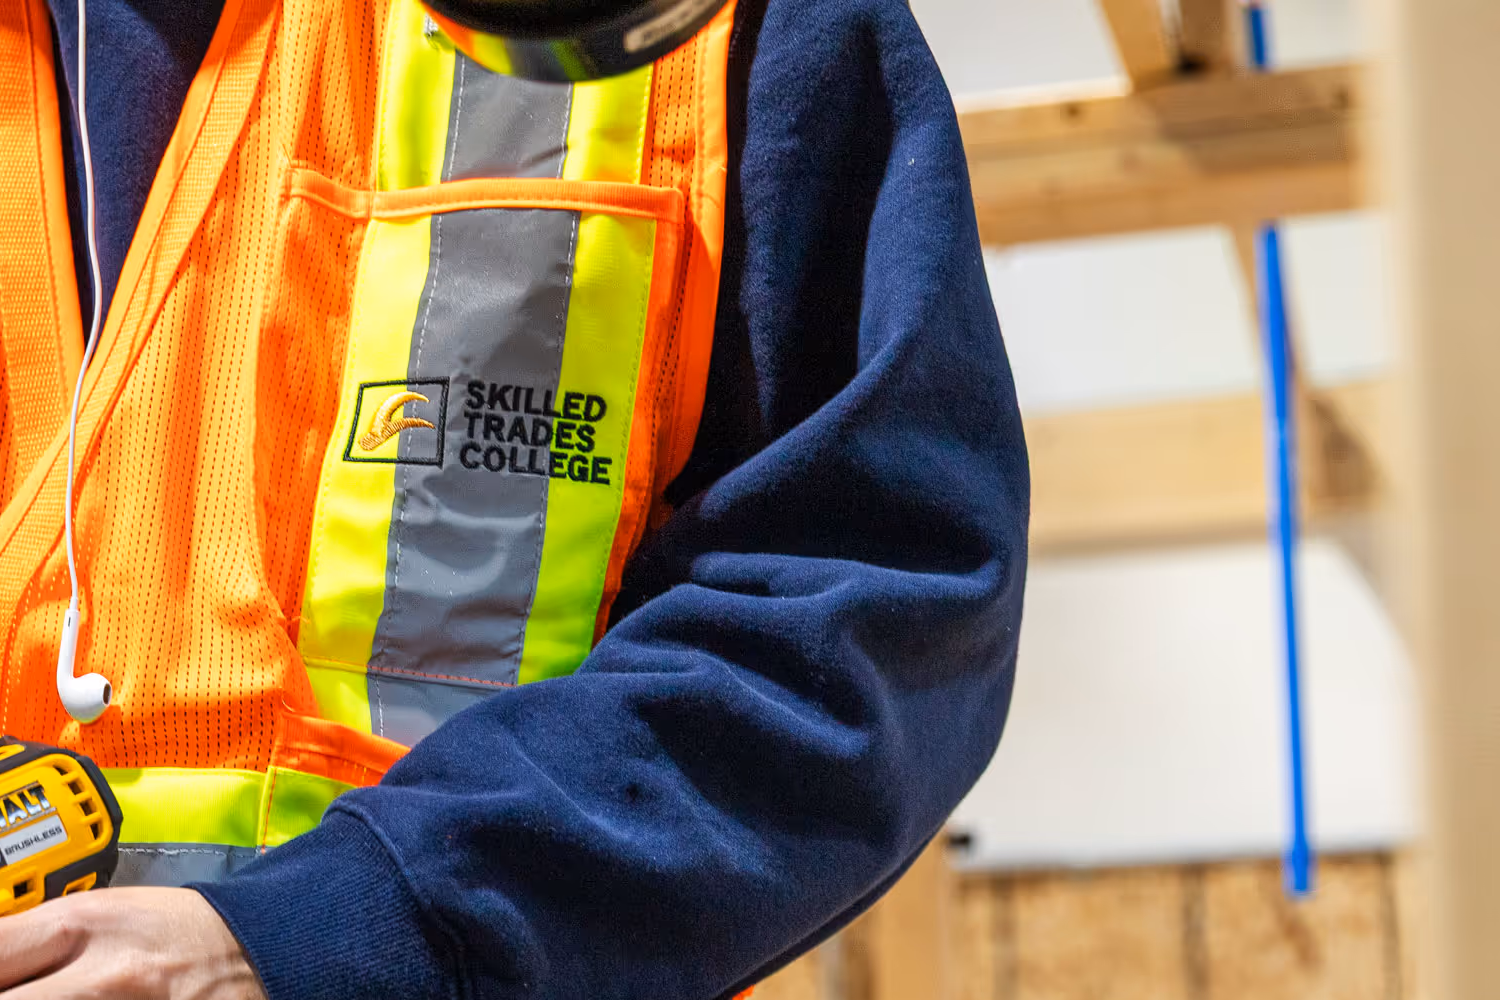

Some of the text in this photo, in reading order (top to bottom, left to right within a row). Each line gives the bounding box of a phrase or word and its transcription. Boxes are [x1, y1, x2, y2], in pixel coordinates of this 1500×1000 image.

[466, 378, 607, 422] SKILLED
[463, 409, 596, 453] TRADES
[459, 440, 613, 485] COLLEGE
[5, 825, 62, 855] BRUSHLESS
